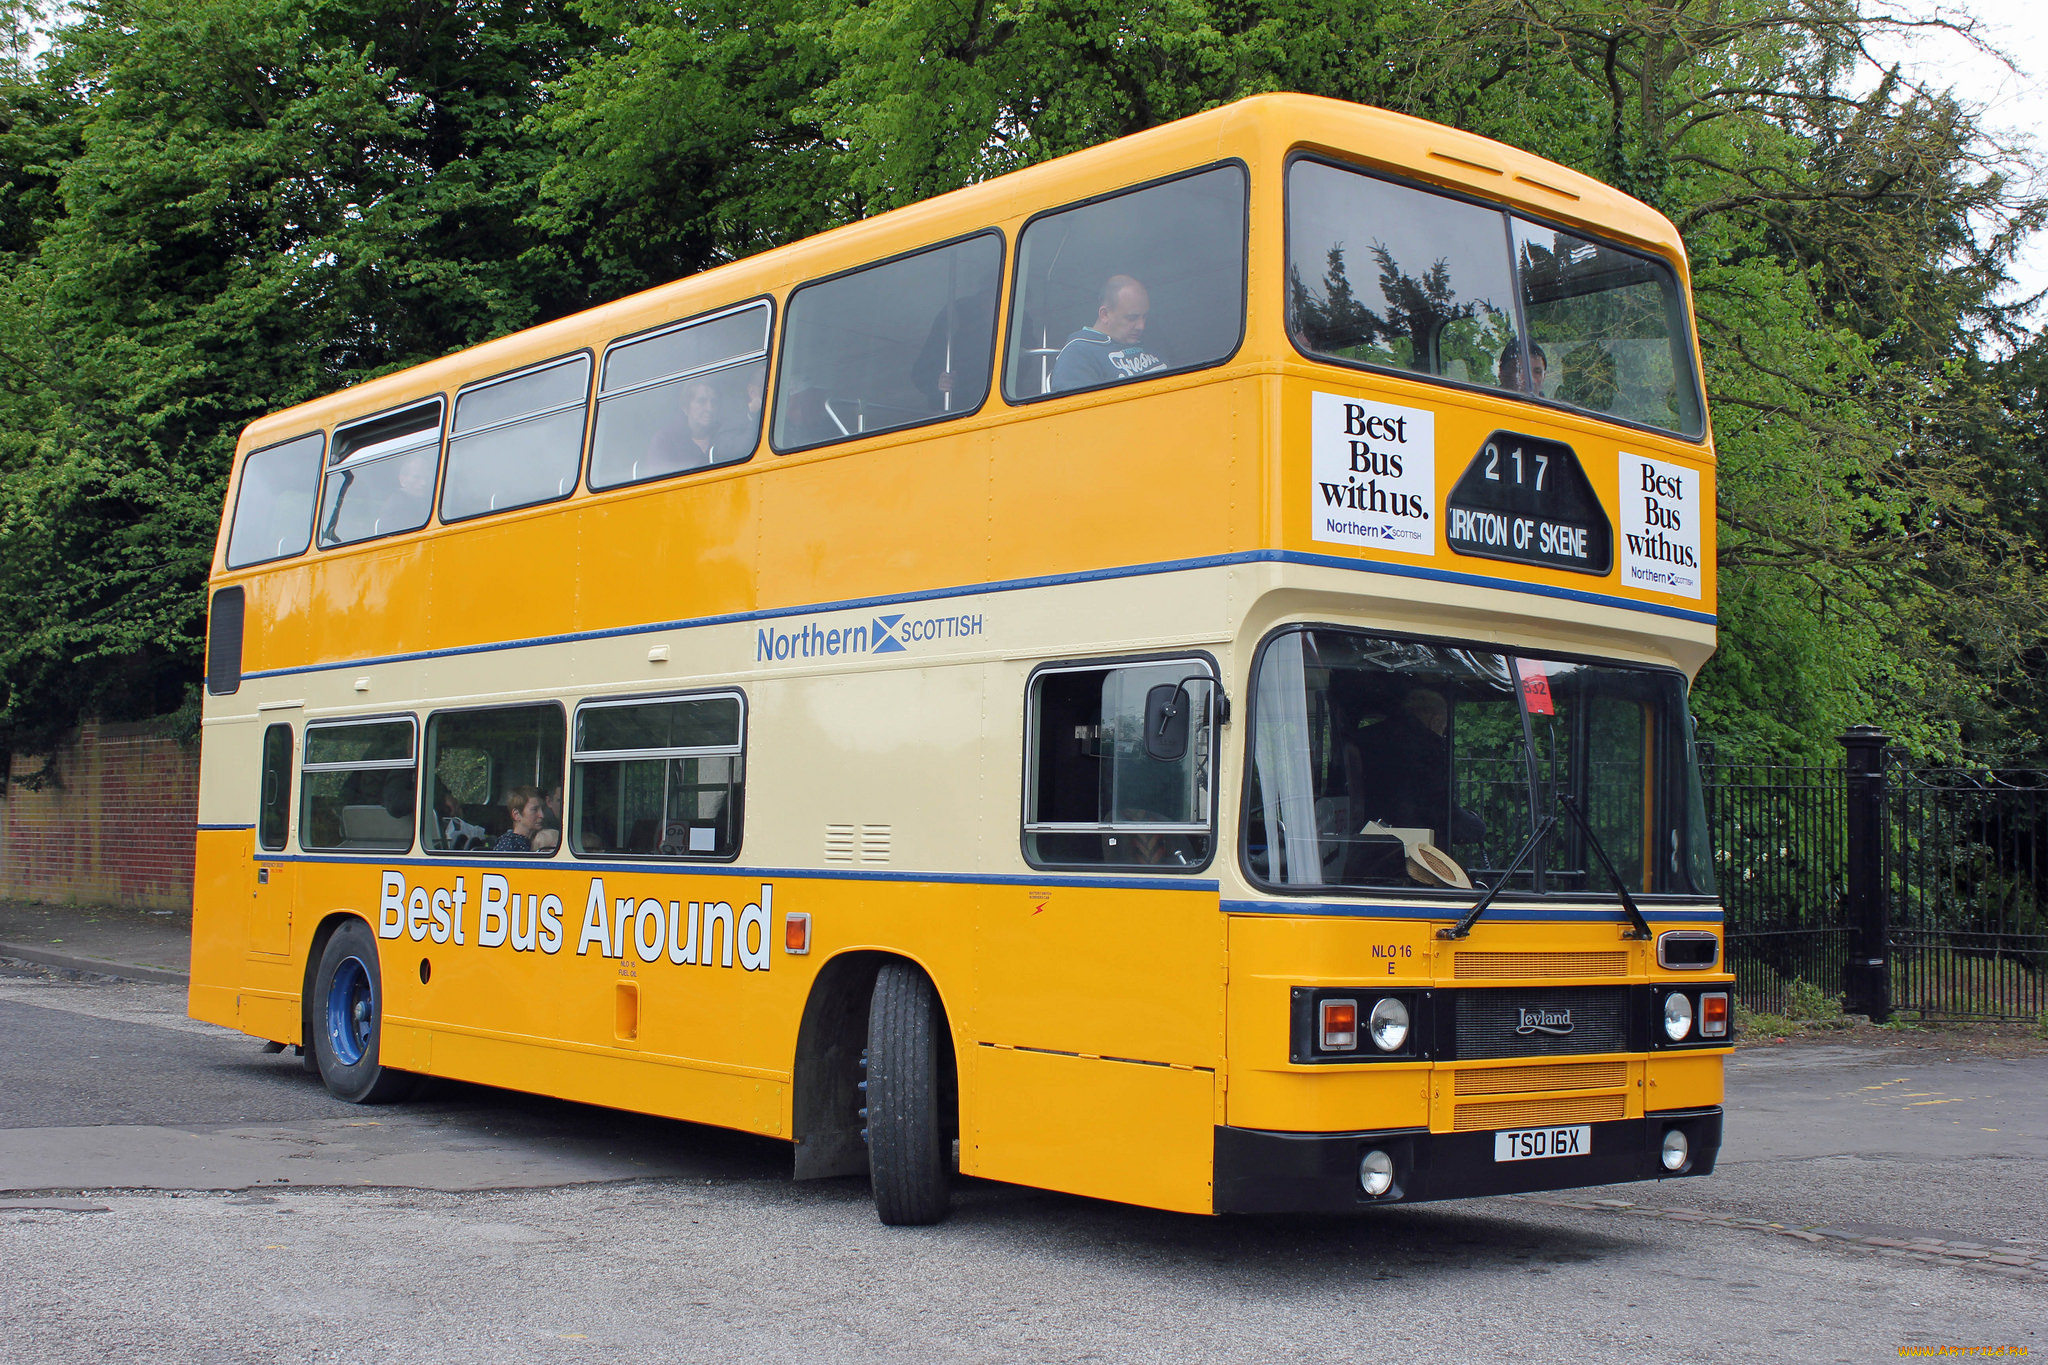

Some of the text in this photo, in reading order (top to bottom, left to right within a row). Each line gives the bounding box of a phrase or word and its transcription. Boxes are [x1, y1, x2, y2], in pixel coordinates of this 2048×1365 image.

[1343, 403, 1408, 444] Best
[1348, 440, 1404, 479] Bus
[1484, 442, 1549, 491] 217
[1640, 463, 1684, 501] Best
[1326, 518, 1422, 540] Northern SCOTTISH
[1643, 496, 1681, 531] Bus
[1449, 507, 1588, 559] IRKTON OF SKENE
[1631, 565, 1667, 584] Northern
[757, 613, 983, 662] Northern SCOTTISH
[378, 870, 774, 971] Best Bus Around
[1371, 944, 1412, 958] NLO 16
[1387, 961, 1396, 975] E
[1516, 1008, 1575, 1035] Leyland
[1507, 1128, 1580, 1158] TSO 16X
